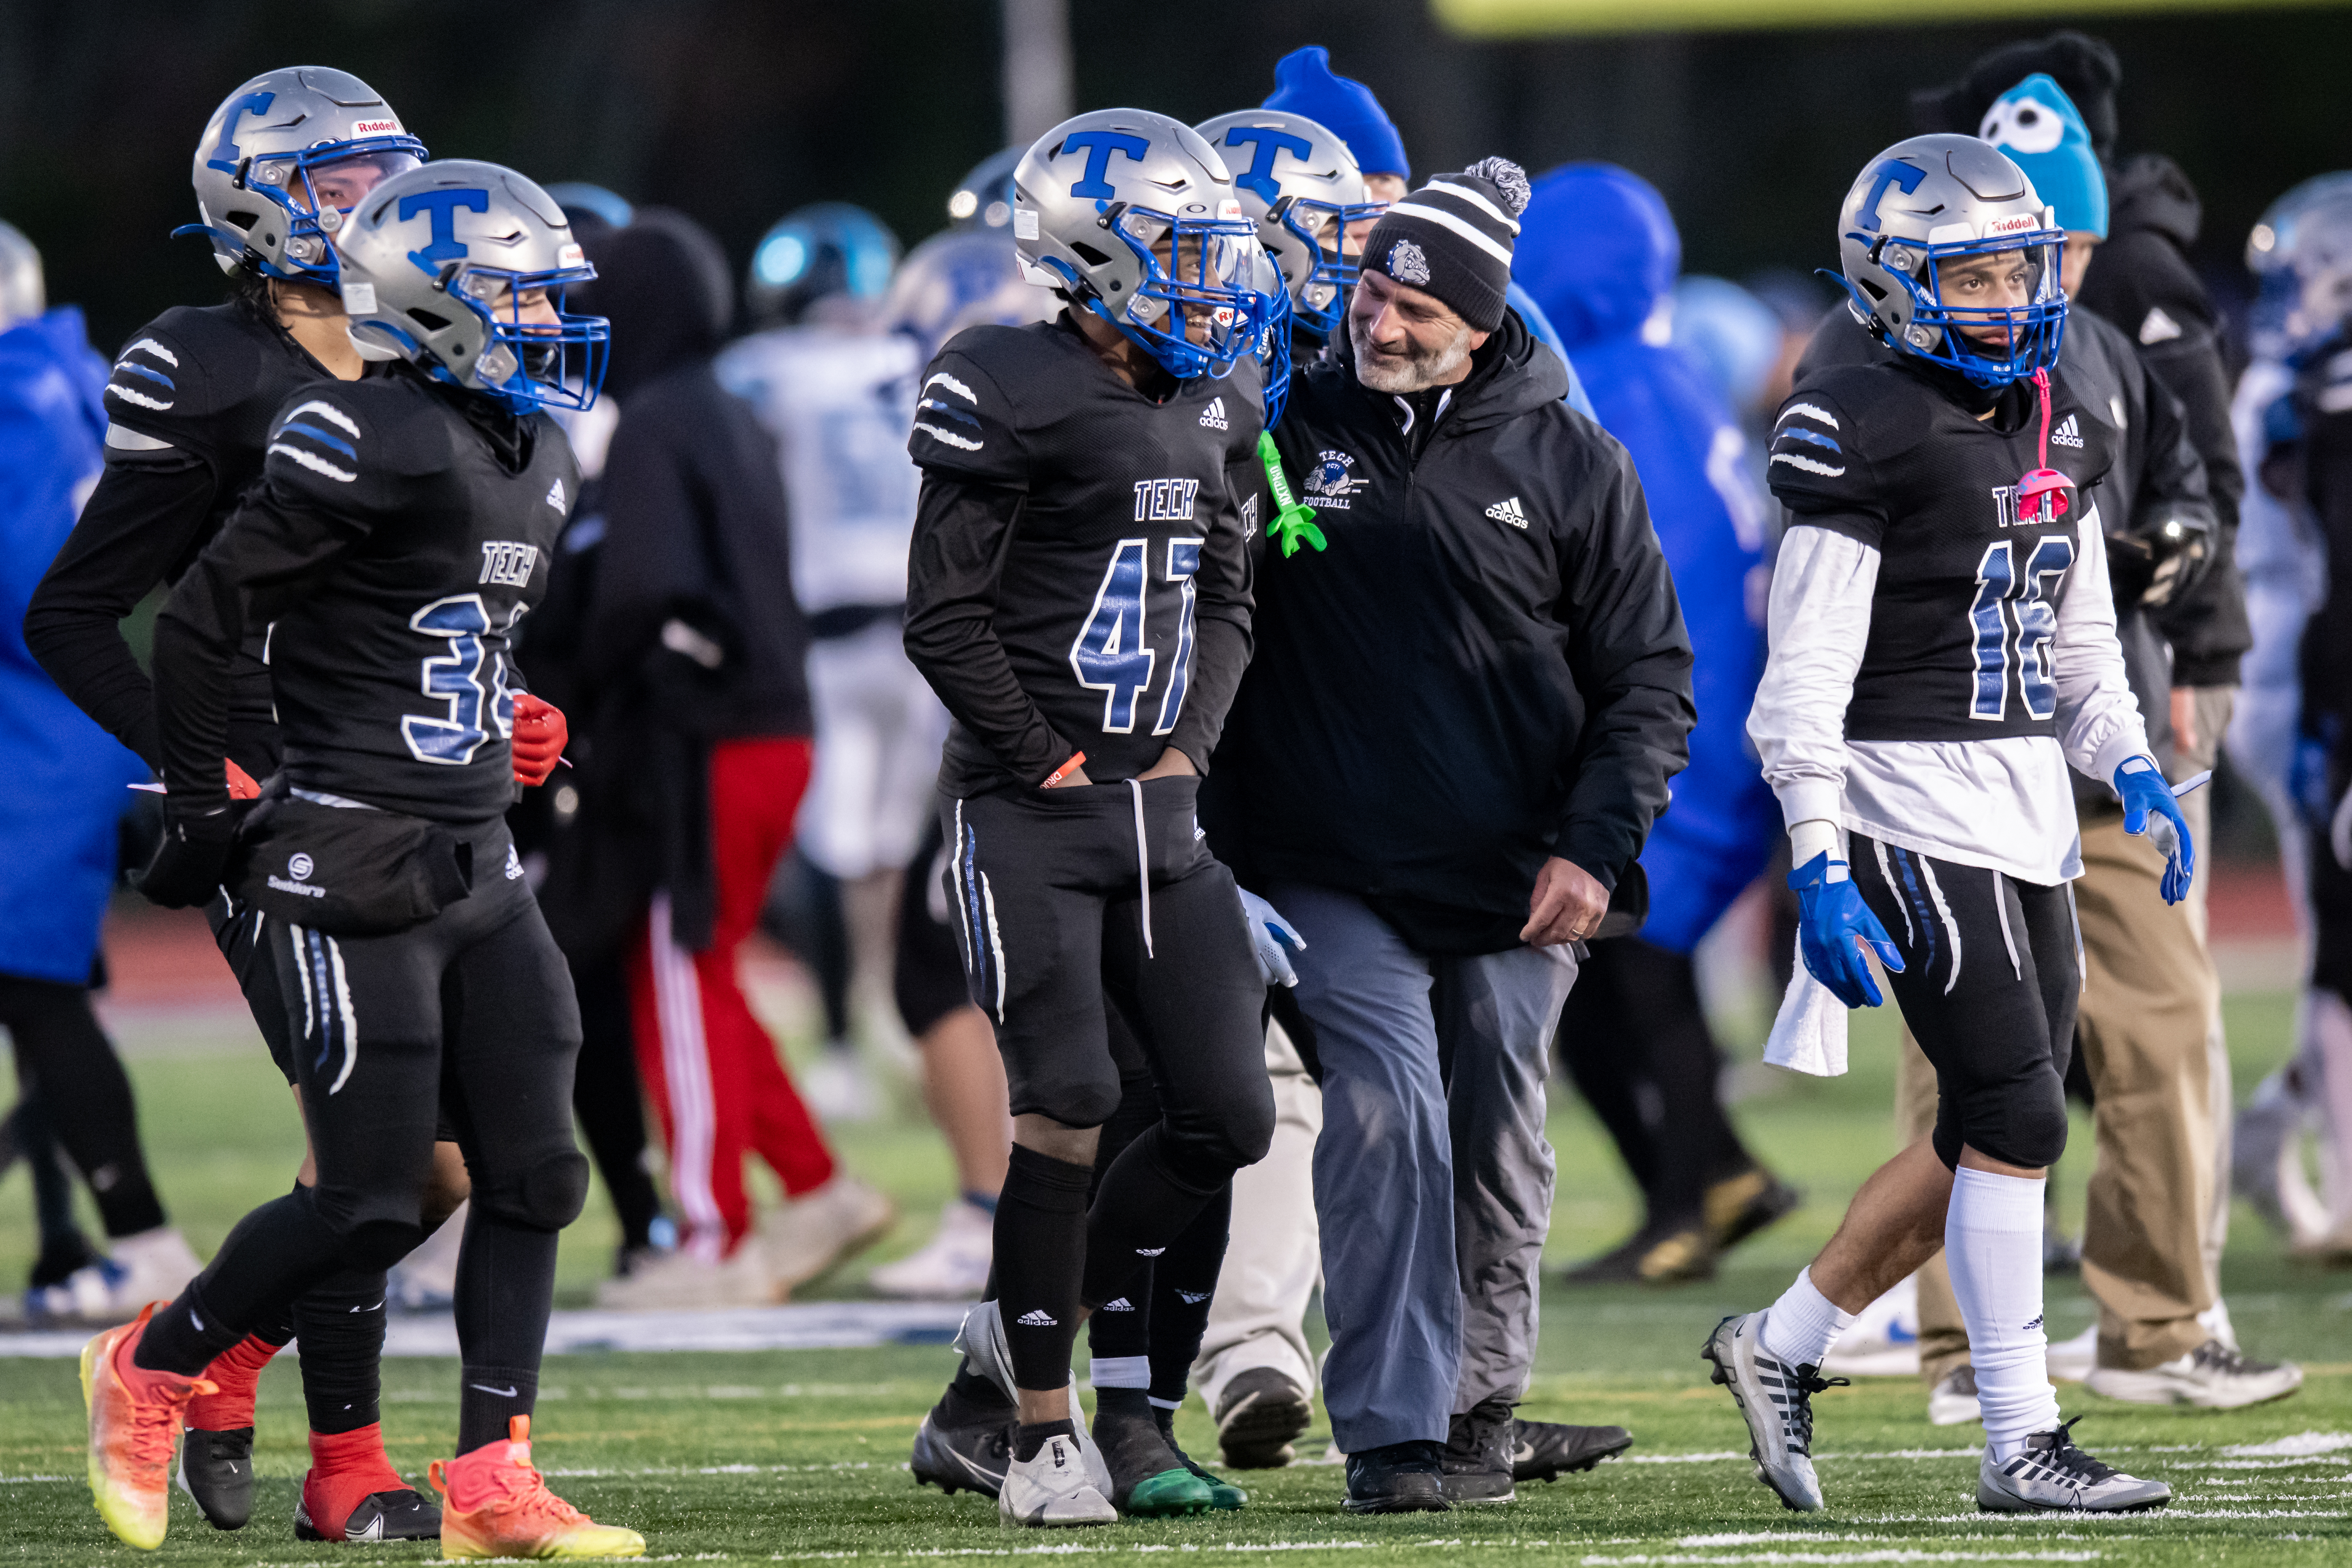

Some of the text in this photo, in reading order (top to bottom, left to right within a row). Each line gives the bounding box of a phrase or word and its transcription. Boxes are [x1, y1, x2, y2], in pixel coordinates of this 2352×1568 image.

[211, 92, 276, 162] T
[358, 121, 397, 132] Riddell
[1061, 131, 1151, 200] T
[1225, 127, 1312, 196] T
[1854, 158, 1928, 233] T
[399, 189, 488, 262] T
[1992, 216, 2034, 232] Riddell
[1199, 416, 1228, 430] adidas
[2051, 434, 2084, 448] adidas
[1319, 450, 1354, 467] TECH
[1134, 478, 1199, 521] TECH
[1303, 496, 1350, 510] FOOTBALL
[1485, 508, 1528, 529] adidas
[478, 541, 538, 588] TECH
[1069, 537, 1205, 736] 47
[1969, 535, 2074, 721] 16
